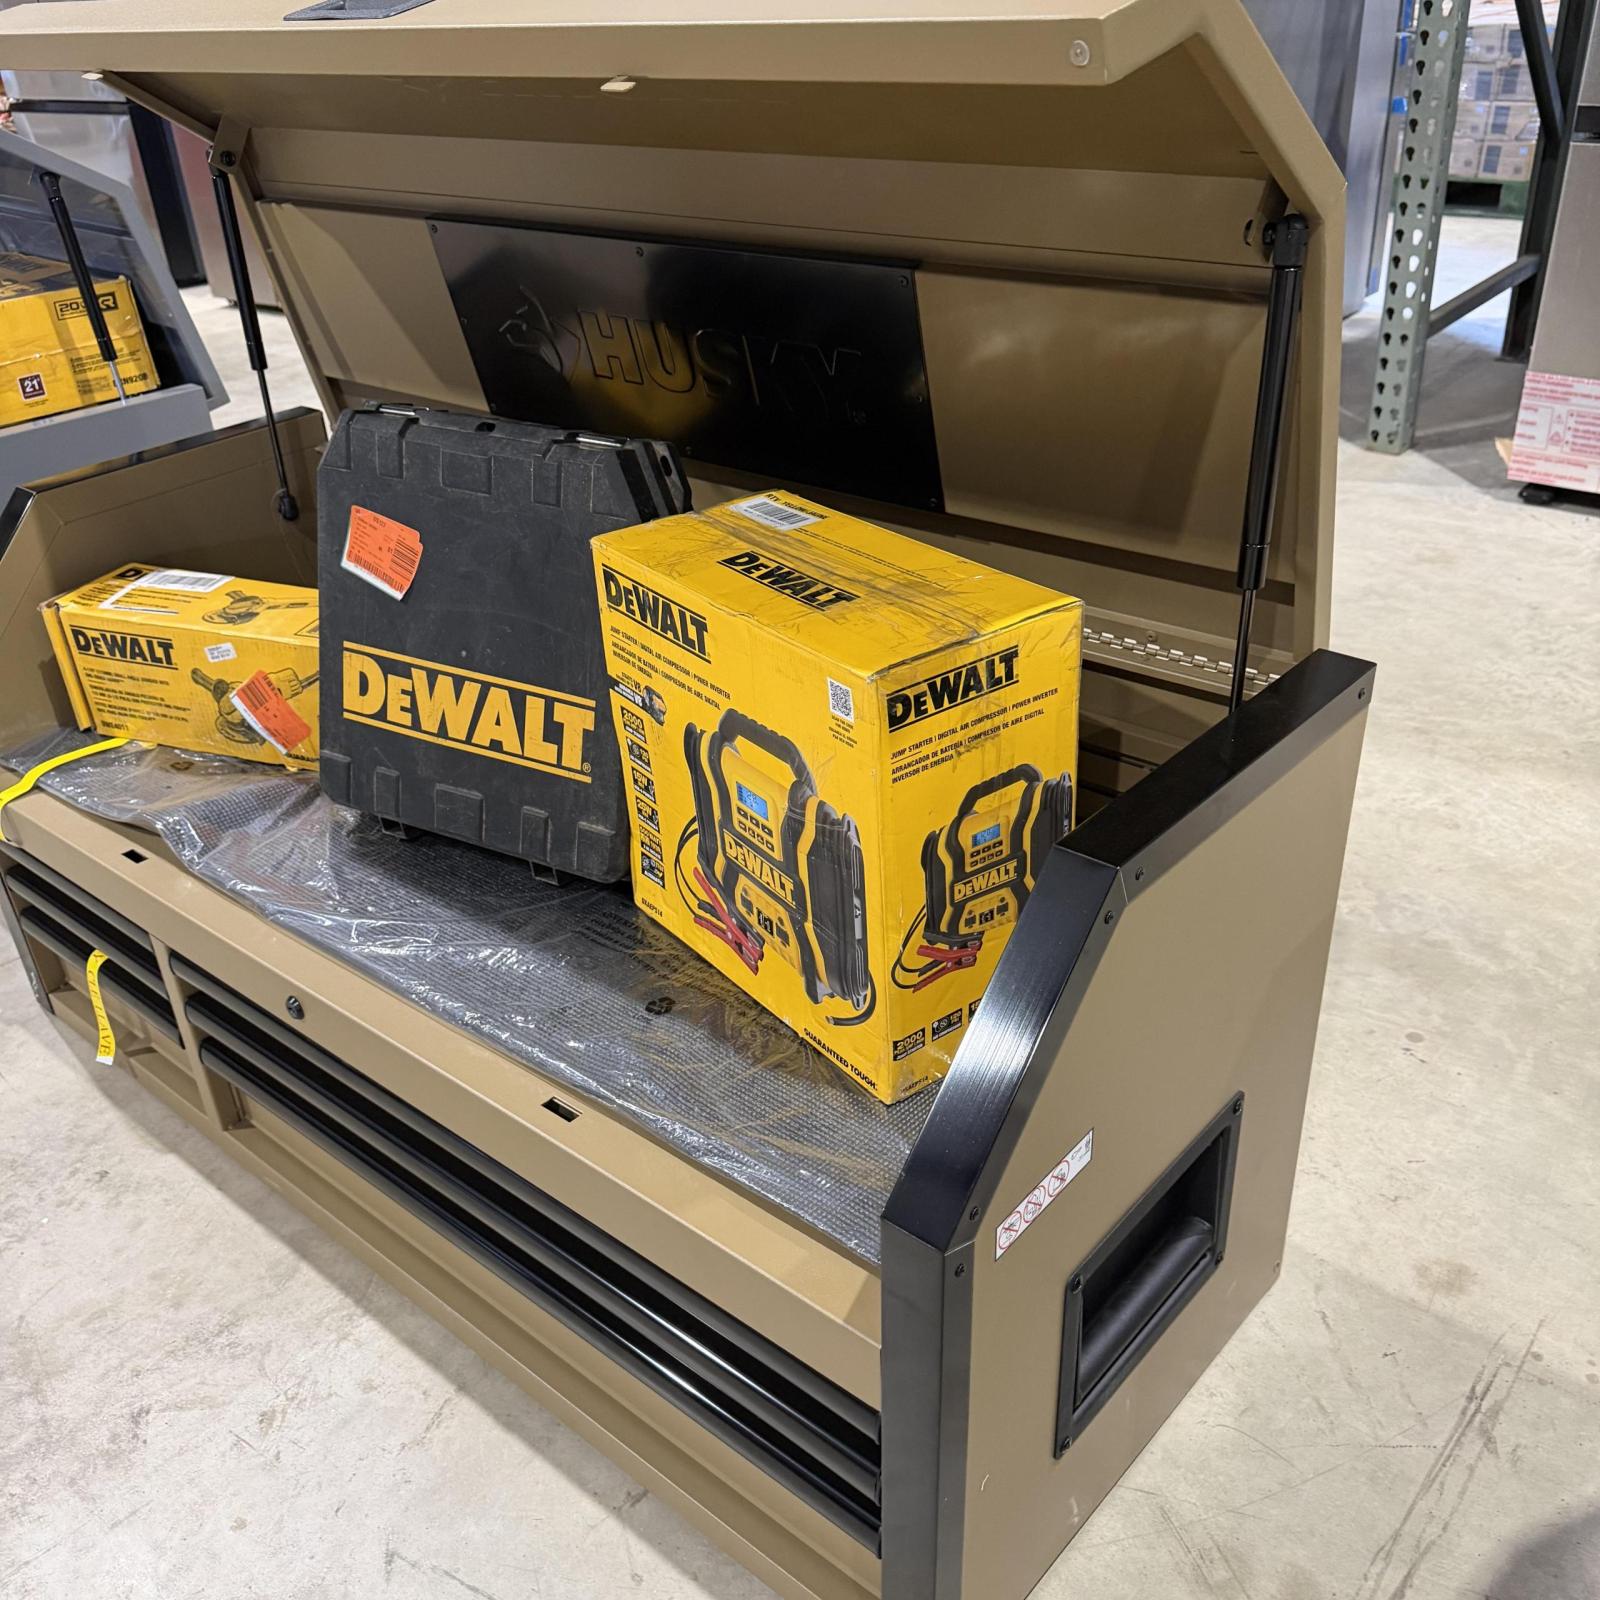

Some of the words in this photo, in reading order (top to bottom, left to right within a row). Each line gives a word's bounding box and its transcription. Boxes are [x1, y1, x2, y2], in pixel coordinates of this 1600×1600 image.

[576, 309, 862, 412] HUSKY
[663, 657, 691, 676] COMPRESSOR
[694, 674, 709, 686] POWER
[710, 682, 731, 700] INVERTER
[891, 749, 907, 760] JUMP
[908, 737, 933, 752] STARTER
[938, 727, 959, 741] DIGITAL
[959, 722, 970, 733] AIR
[970, 708, 1008, 728] COMPRESSOR
[1011, 698, 1032, 711] POWER
[1032, 688, 1059, 703] INVERTER
[892, 754, 930, 775] ARRANCADOR
[931, 751, 939, 759] DE
[967, 726, 1002, 745] COMPRESOR
[1011, 716, 1024, 726] AIRE
[1024, 708, 1045, 721] DIGITAL
[892, 768, 921, 784] INVERSOR
[804, 1028, 849, 1068] GUARANTEED
[896, 1030, 923, 1050] 2000
